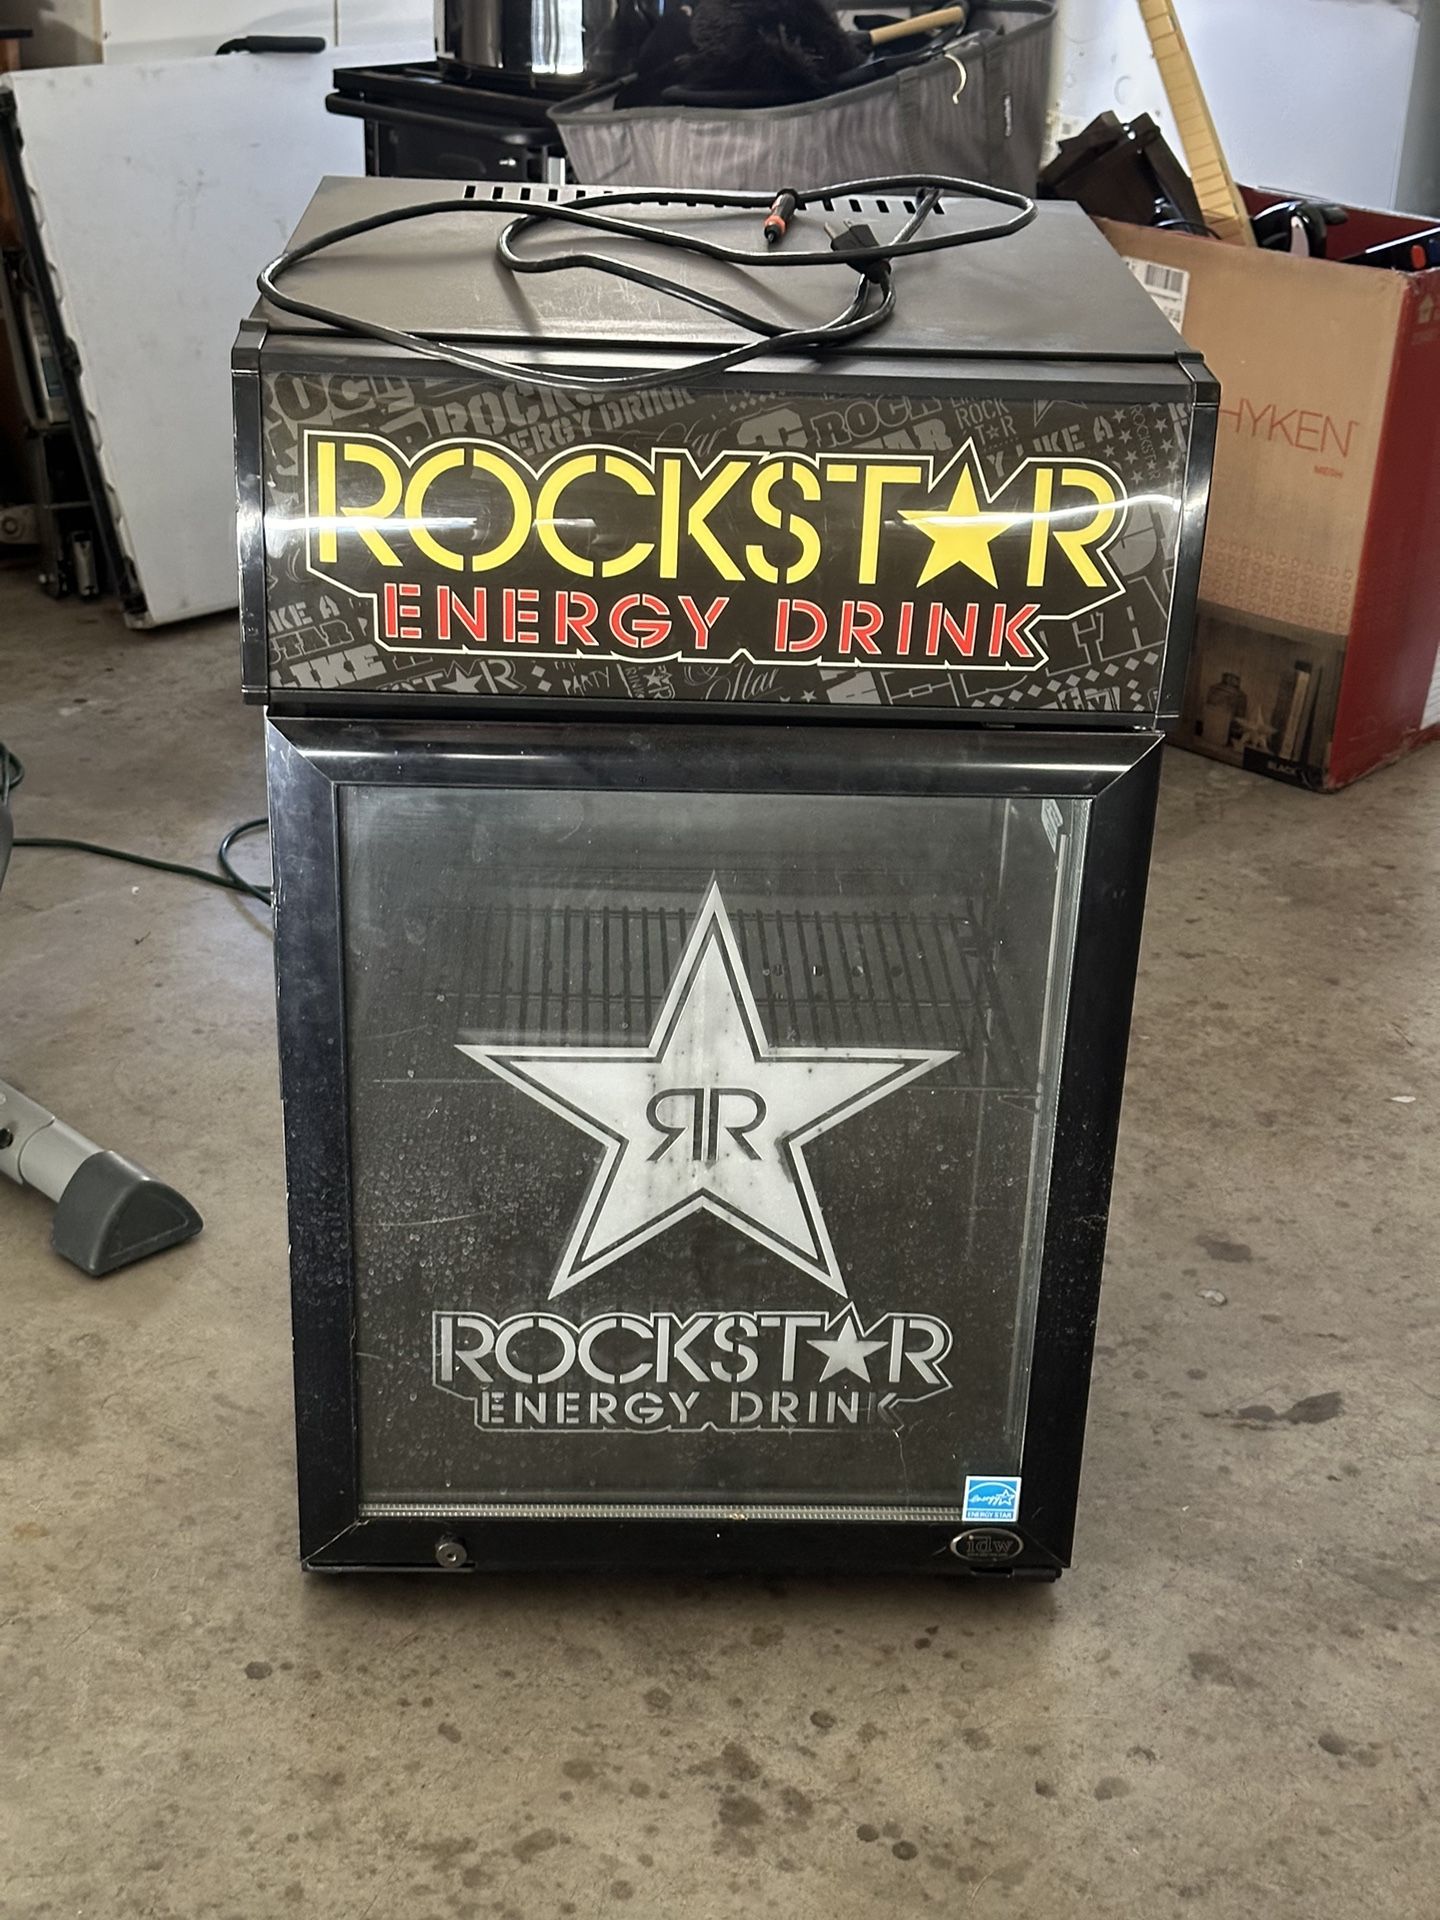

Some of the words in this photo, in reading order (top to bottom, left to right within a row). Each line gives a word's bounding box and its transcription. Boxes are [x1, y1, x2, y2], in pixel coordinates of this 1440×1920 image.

[501, 404, 592, 457] ERGY
[954, 395, 1011, 430] ROCK
[316, 441, 1108, 590] ROCKSTAR
[383, 583, 731, 650] ENERGY
[773, 598, 1041, 658] DRINK
[562, 666, 611, 696] PARTY
[440, 1315, 941, 1385] ROCKSTAR
[482, 1391, 701, 1425] ENERGY
[730, 1391, 898, 1425] DRINK
[994, 1511, 1012, 1519] STAR
